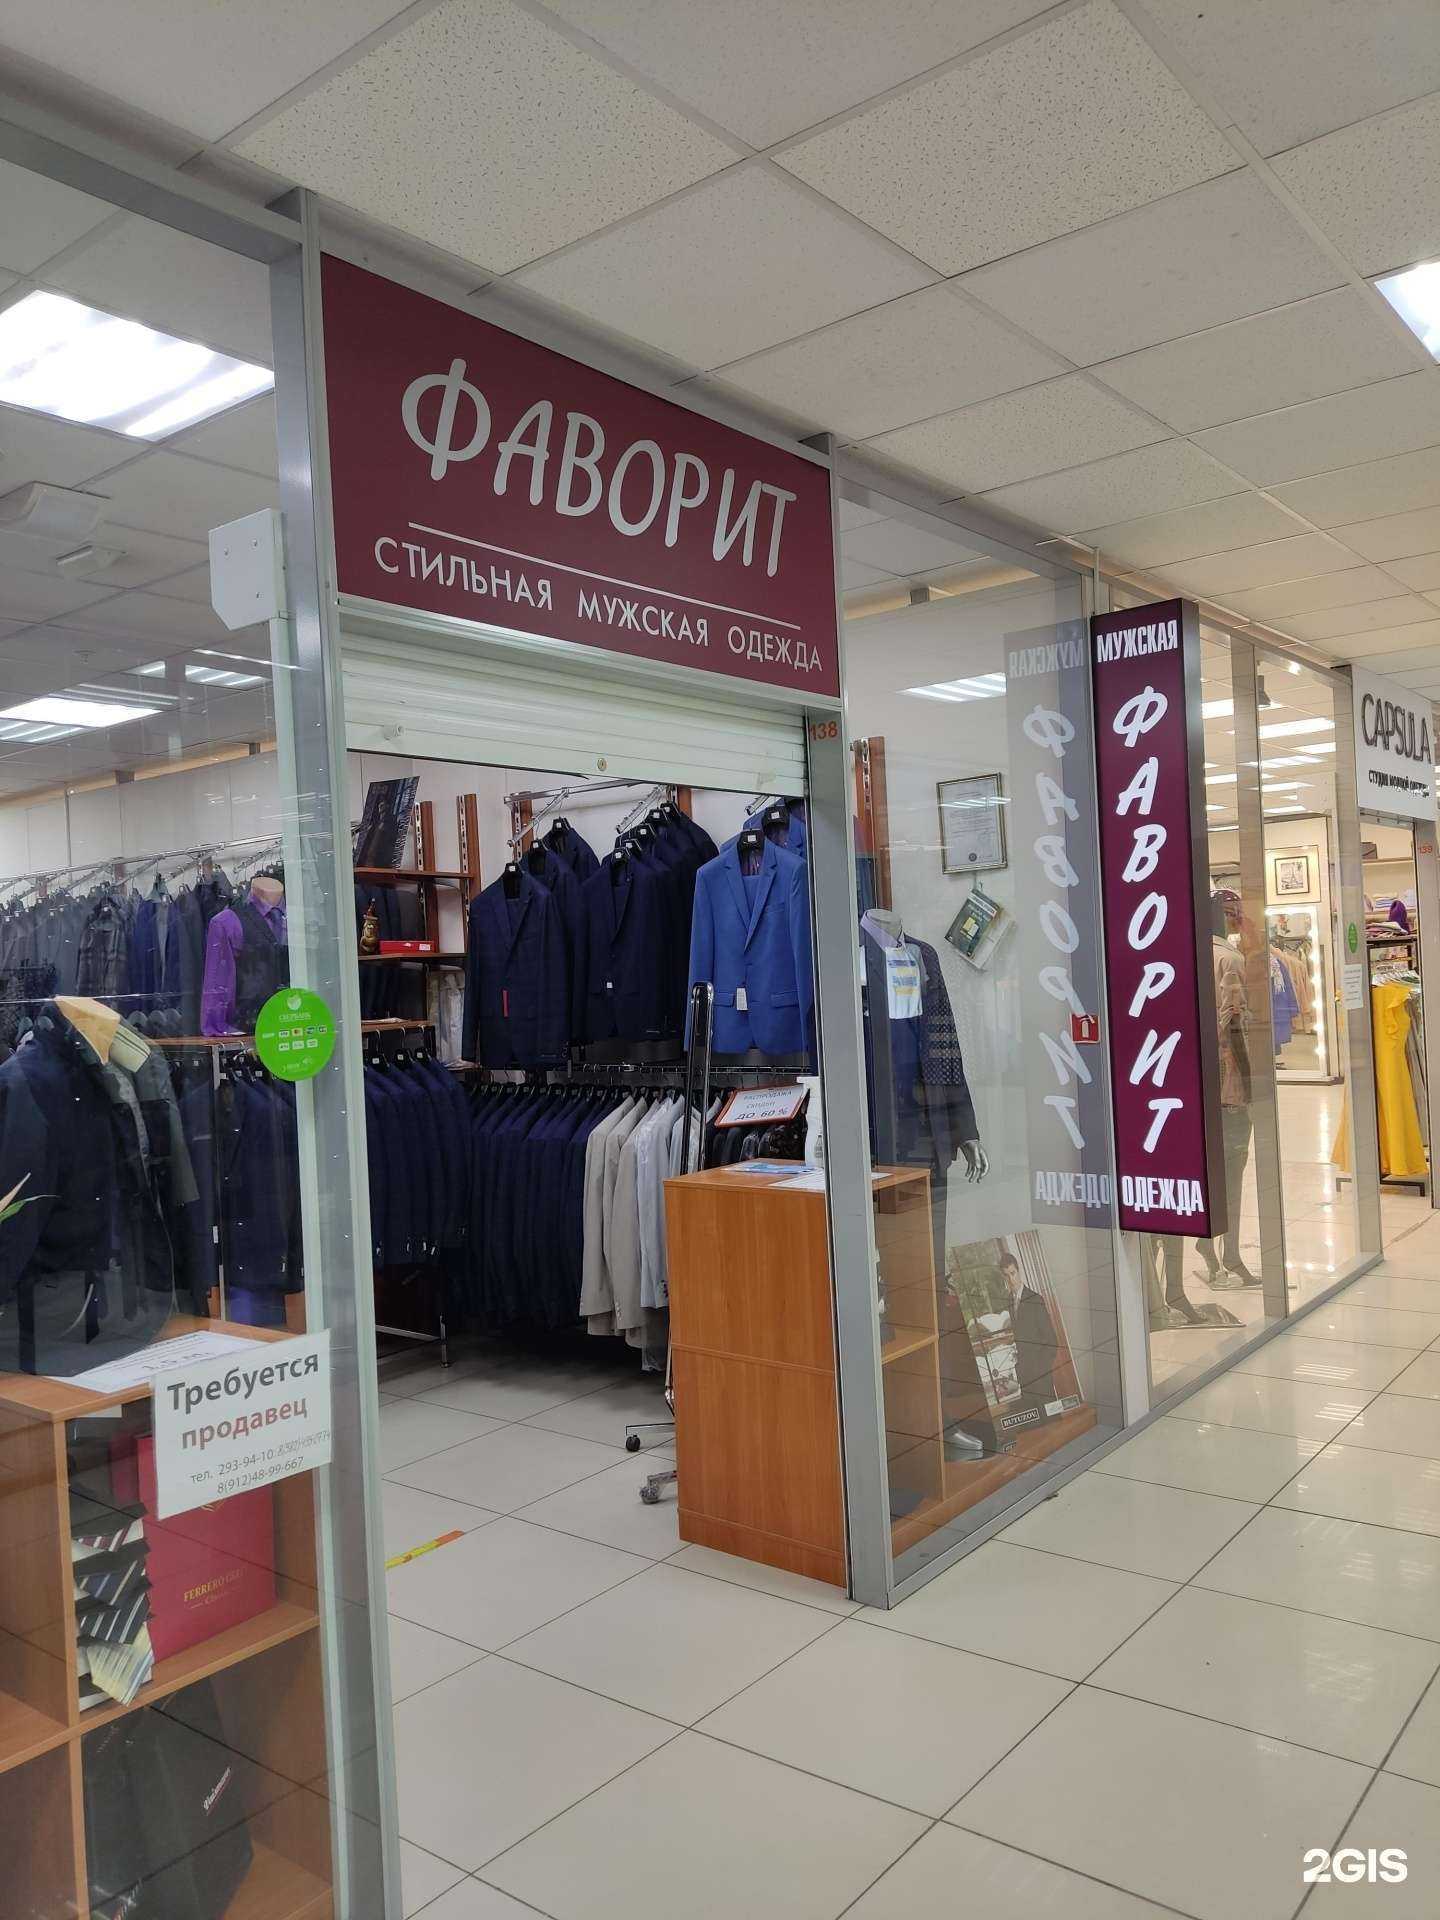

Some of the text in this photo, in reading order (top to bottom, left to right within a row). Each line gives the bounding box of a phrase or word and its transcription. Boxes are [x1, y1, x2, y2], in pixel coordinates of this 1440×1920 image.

[401, 358, 798, 578] ФАВОРИТ
[374, 536, 823, 673] СТИЛЬНАЯ МУЖСКАЯ ОДЕЖДА
[1096, 619, 1179, 664] МУЖСКАЯ
[811, 720, 838, 740] 138
[1361, 693, 1432, 765] CAPSULA
[1112, 685, 1184, 1154] ФАВОРИТ
[735, 1112, 755, 1121] ДО
[761, 1109, 776, 1118] 60
[1121, 1175, 1205, 1217] ОДЕЖДА
[167, 1353, 319, 1415] Требуется
[182, 1398, 308, 1450] продавец
[191, 1470, 213, 1484] тел.
[184, 1576, 225, 1602] FERRERO
